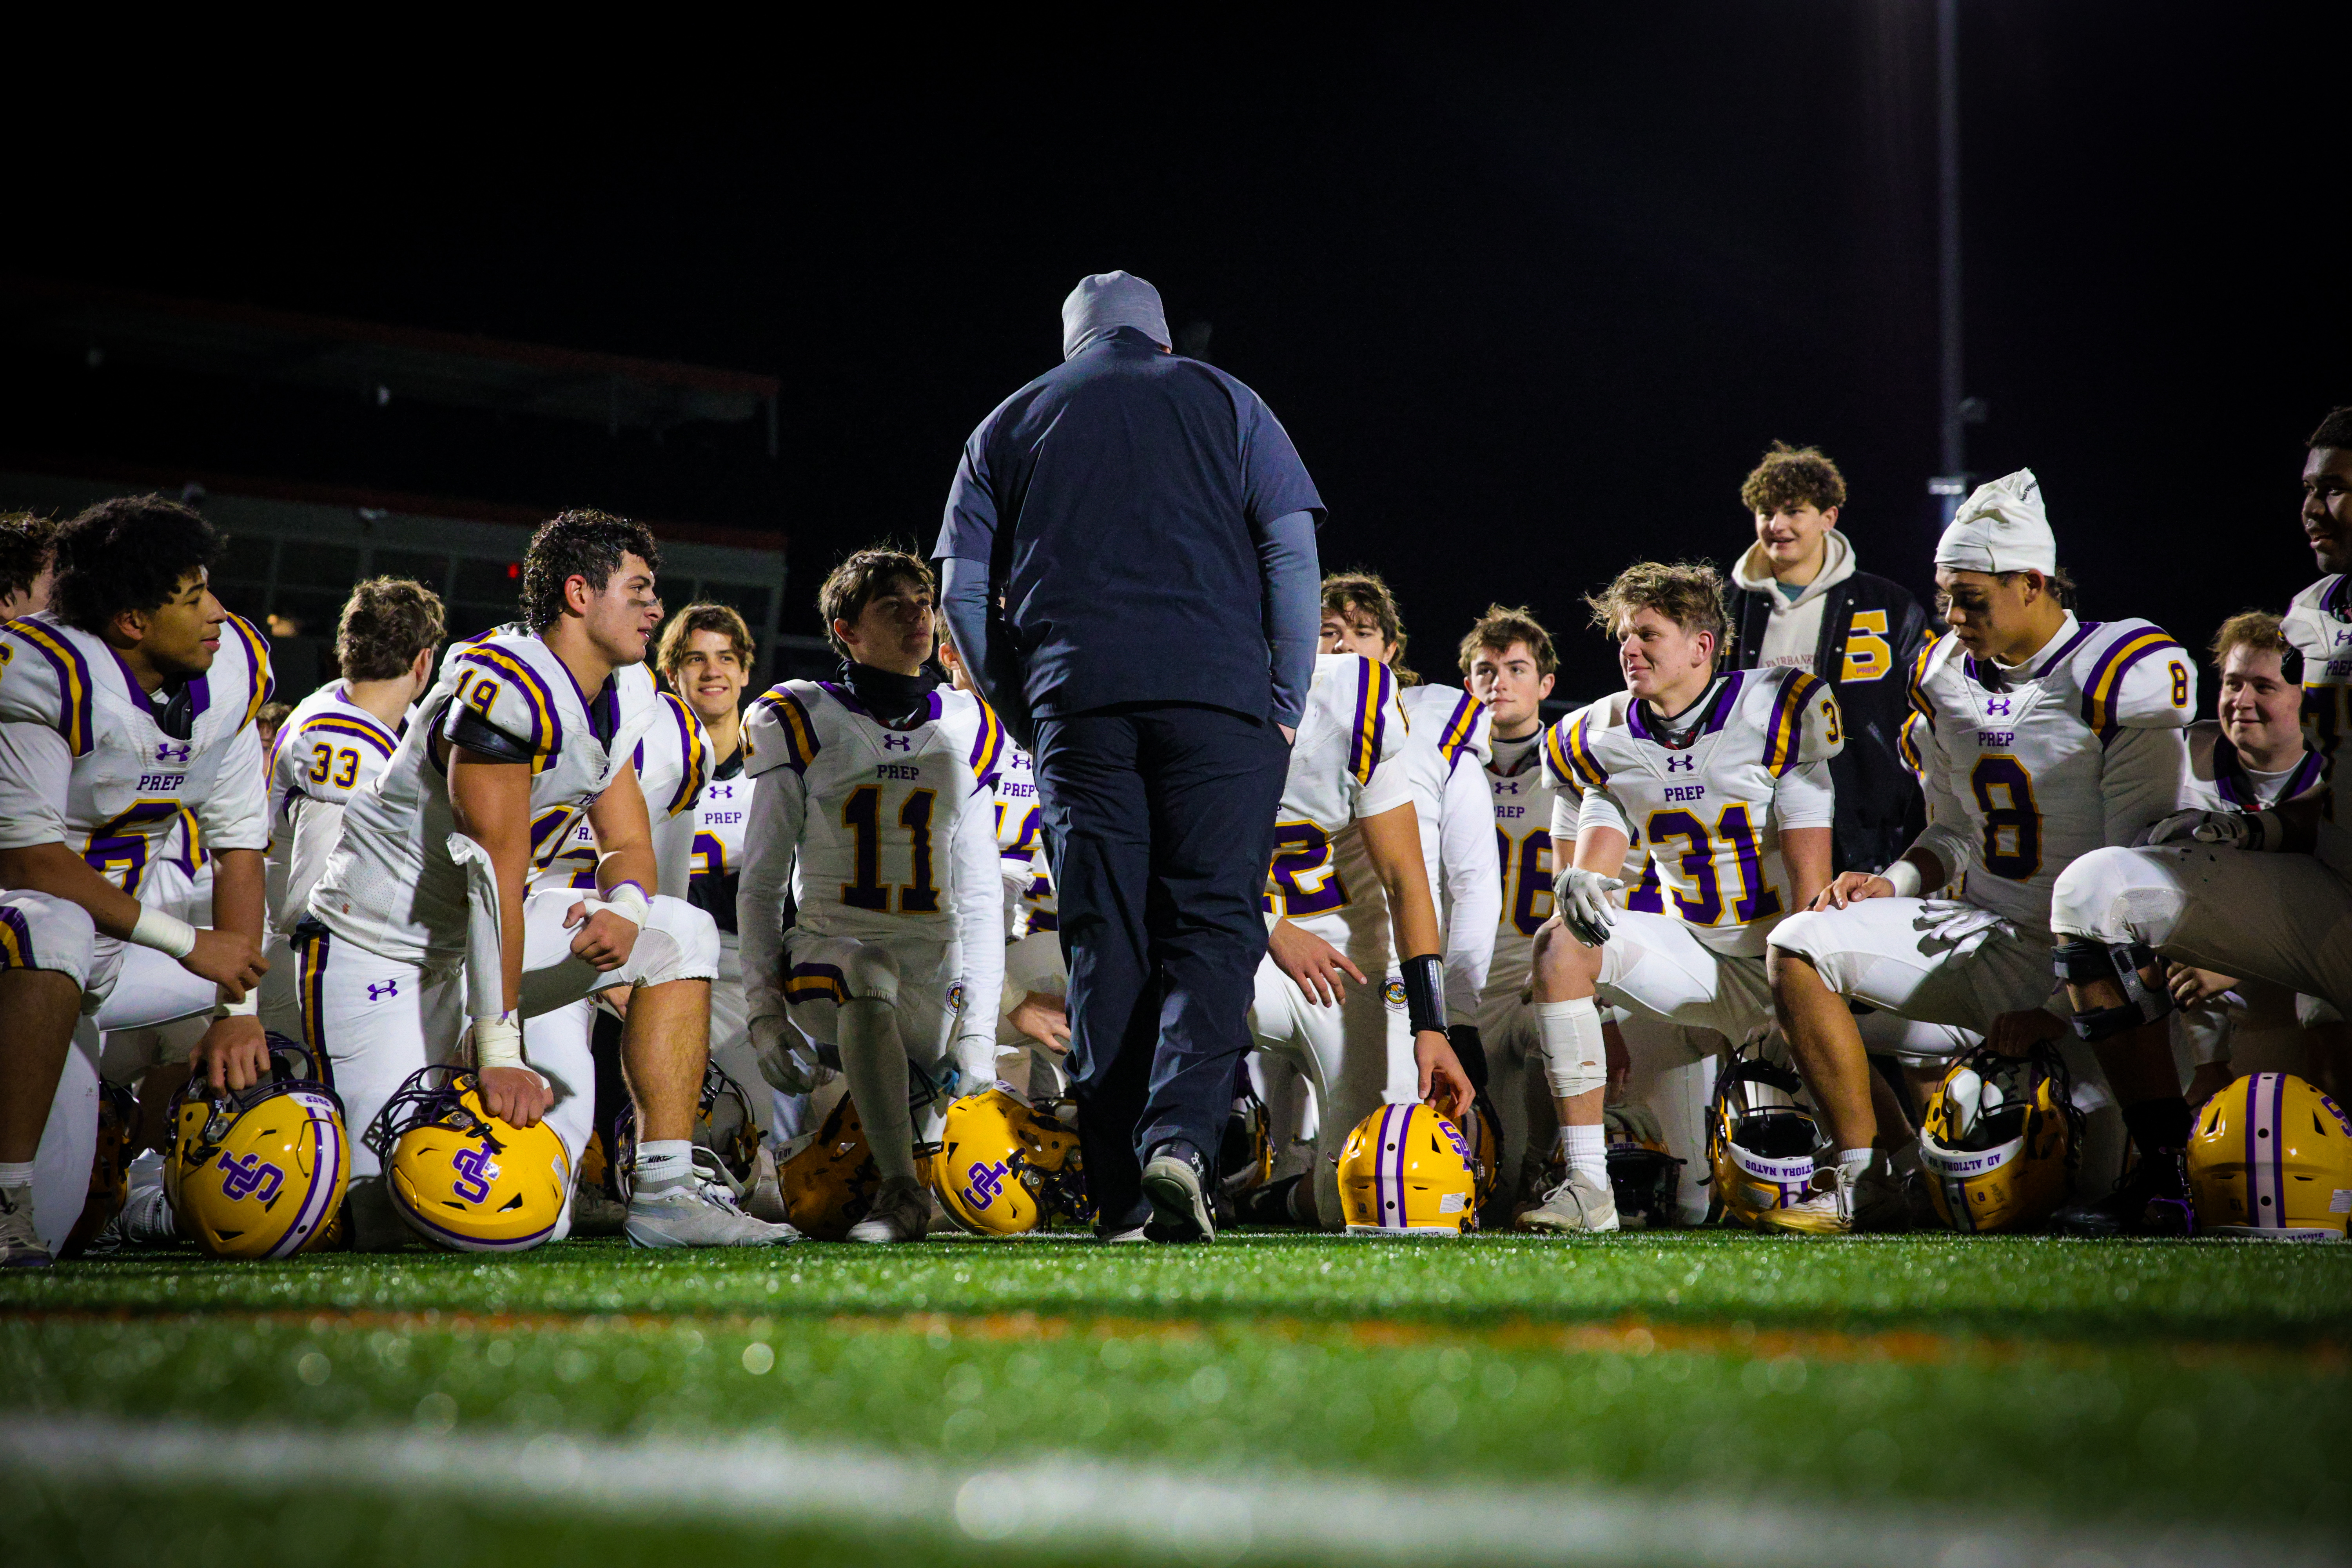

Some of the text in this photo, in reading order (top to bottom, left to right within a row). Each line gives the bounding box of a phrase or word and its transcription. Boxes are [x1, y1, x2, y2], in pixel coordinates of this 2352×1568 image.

[2168, 660, 2189, 708] 8
[454, 668, 501, 720] 19
[1978, 732, 2014, 747] PREP
[309, 742, 361, 790] 33
[877, 764, 919, 780] PREP
[137, 776, 184, 790] PREP
[1003, 782, 1035, 797] PREP
[1664, 786, 1705, 802] PREP
[705, 812, 742, 824] PREP
[1494, 805, 1525, 818] REP
[1970, 754, 2043, 883] 8
[841, 784, 941, 914] 11
[1262, 818, 1352, 919] 2
[1646, 801, 1785, 927] 31
[1745, 1160, 1777, 1176] NATUS
[1941, 1159, 1982, 1171] ALTIORA
[1987, 1154, 2001, 1166] AD
